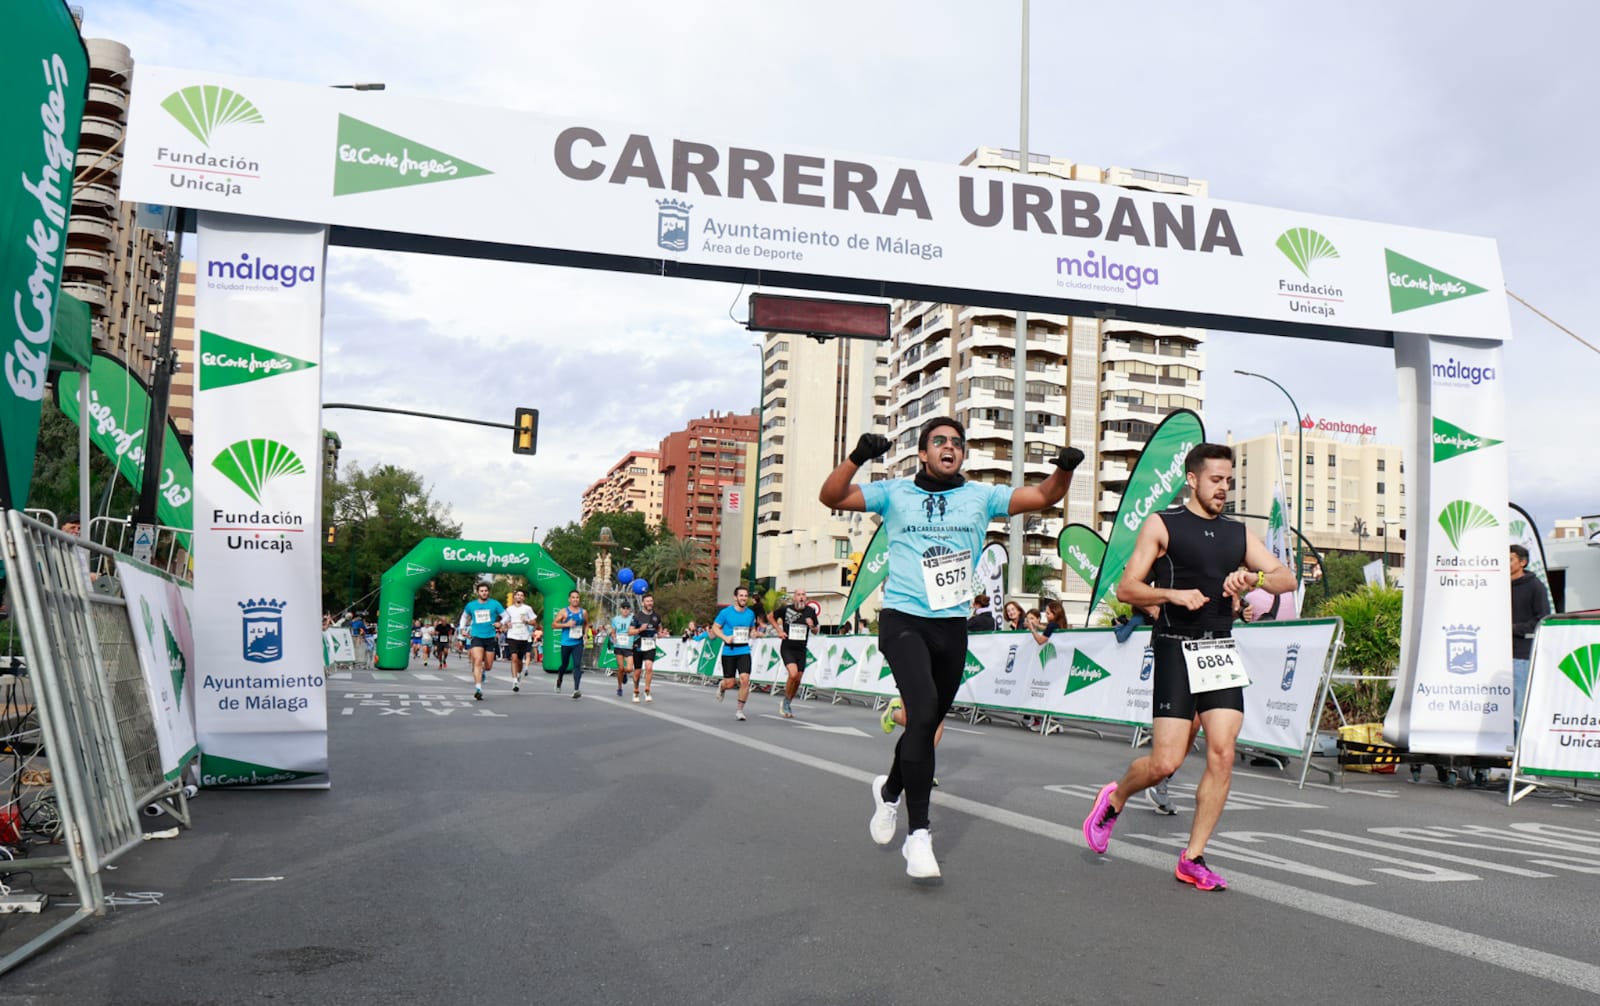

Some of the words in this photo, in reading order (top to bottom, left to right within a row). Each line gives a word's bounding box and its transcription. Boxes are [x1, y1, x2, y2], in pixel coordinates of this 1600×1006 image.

[157, 148, 260, 172] Fundación
[340, 145, 356, 162] El
[358, 148, 398, 168] Corte
[170, 174, 242, 196] Unicaja
[554, 126, 933, 220] CARRERA
[959, 175, 1243, 256] URBANA
[703, 218, 839, 247] Ayuntamiento
[847, 233, 869, 250] de
[876, 236, 943, 260] Málaga
[702, 237, 732, 255] Área
[735, 243, 750, 256] de
[753, 245, 803, 261] Deporte
[14, 218, 59, 344] Corte
[1065, 280, 1092, 289] ciudad
[1278, 279, 1343, 297] Fundación
[1389, 272, 1401, 287] El
[1402, 274, 1428, 289] Corte
[1289, 300, 1335, 317] Unicaja
[202, 352, 217, 366] El
[217, 354, 248, 368] Corte
[5, 340, 47, 401] El
[1319, 419, 1377, 435] Santander
[1123, 511, 1142, 531] El
[1135, 483, 1164, 517] Corte
[213, 509, 303, 525] Fundación
[227, 534, 293, 554] Unicaja
[442, 546, 455, 561] El
[457, 548, 486, 563] Corte
[923, 558, 939, 568] 43
[1435, 555, 1499, 567] Fundación
[935, 567, 966, 587] 6575
[1440, 574, 1488, 589] Unicaja
[1197, 654, 1233, 669] 6884
[203, 674, 324, 692] Ayuntamiento
[1416, 683, 1511, 697] Ayuntamiento
[218, 696, 241, 711] de
[245, 695, 309, 712] Málaga
[1427, 701, 1444, 712] de
[1450, 700, 1499, 714] Málaga
[341, 707, 509, 718] TAXI
